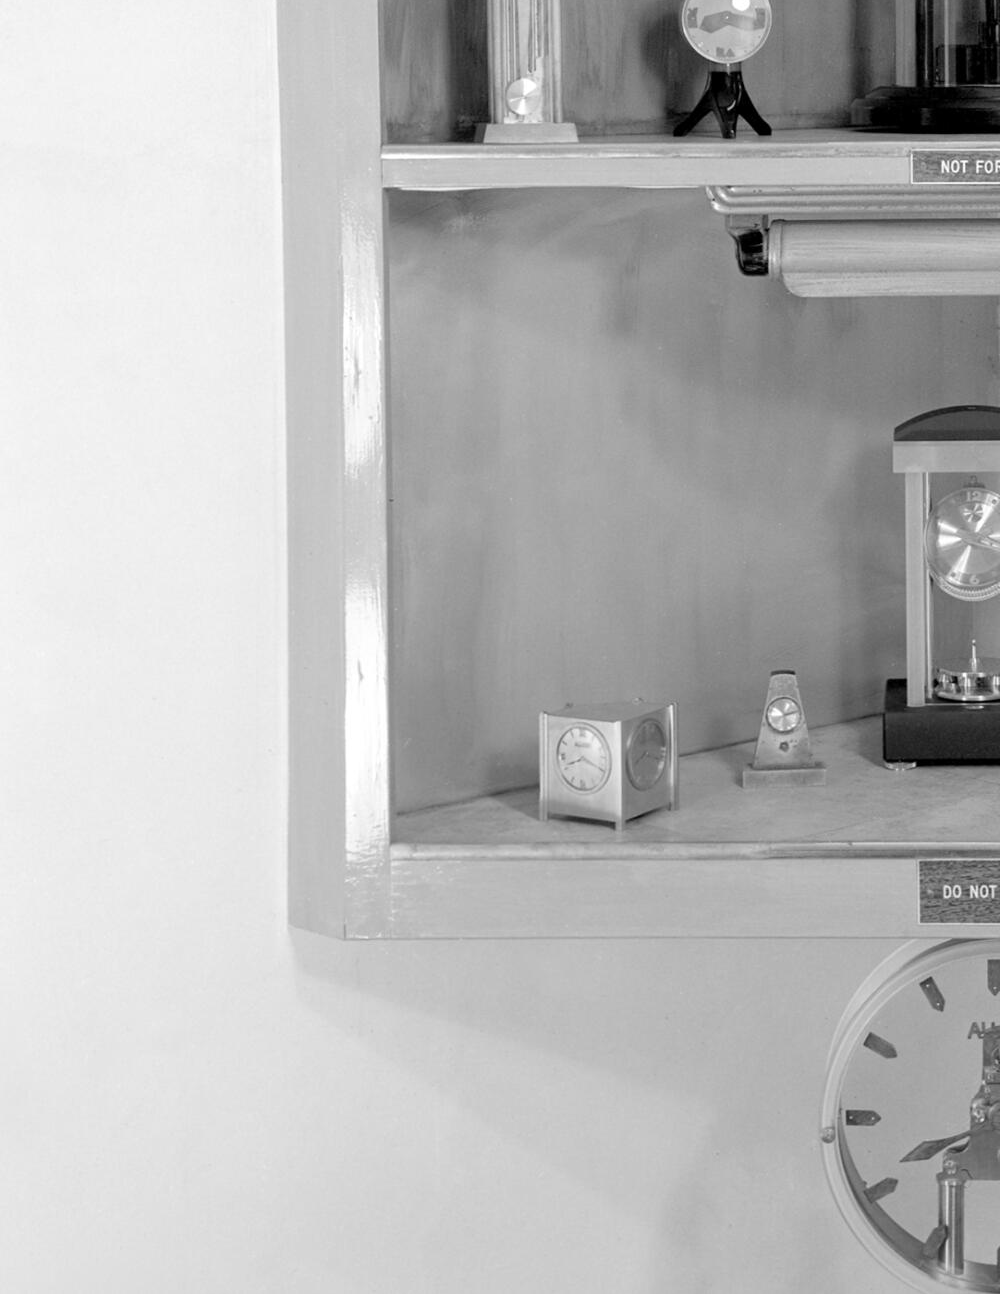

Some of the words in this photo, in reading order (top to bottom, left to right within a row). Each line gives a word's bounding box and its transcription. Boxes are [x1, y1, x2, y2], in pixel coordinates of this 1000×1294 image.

[940, 159, 969, 174] NOT
[942, 884, 963, 899] DO
[969, 884, 998, 899] NOT
